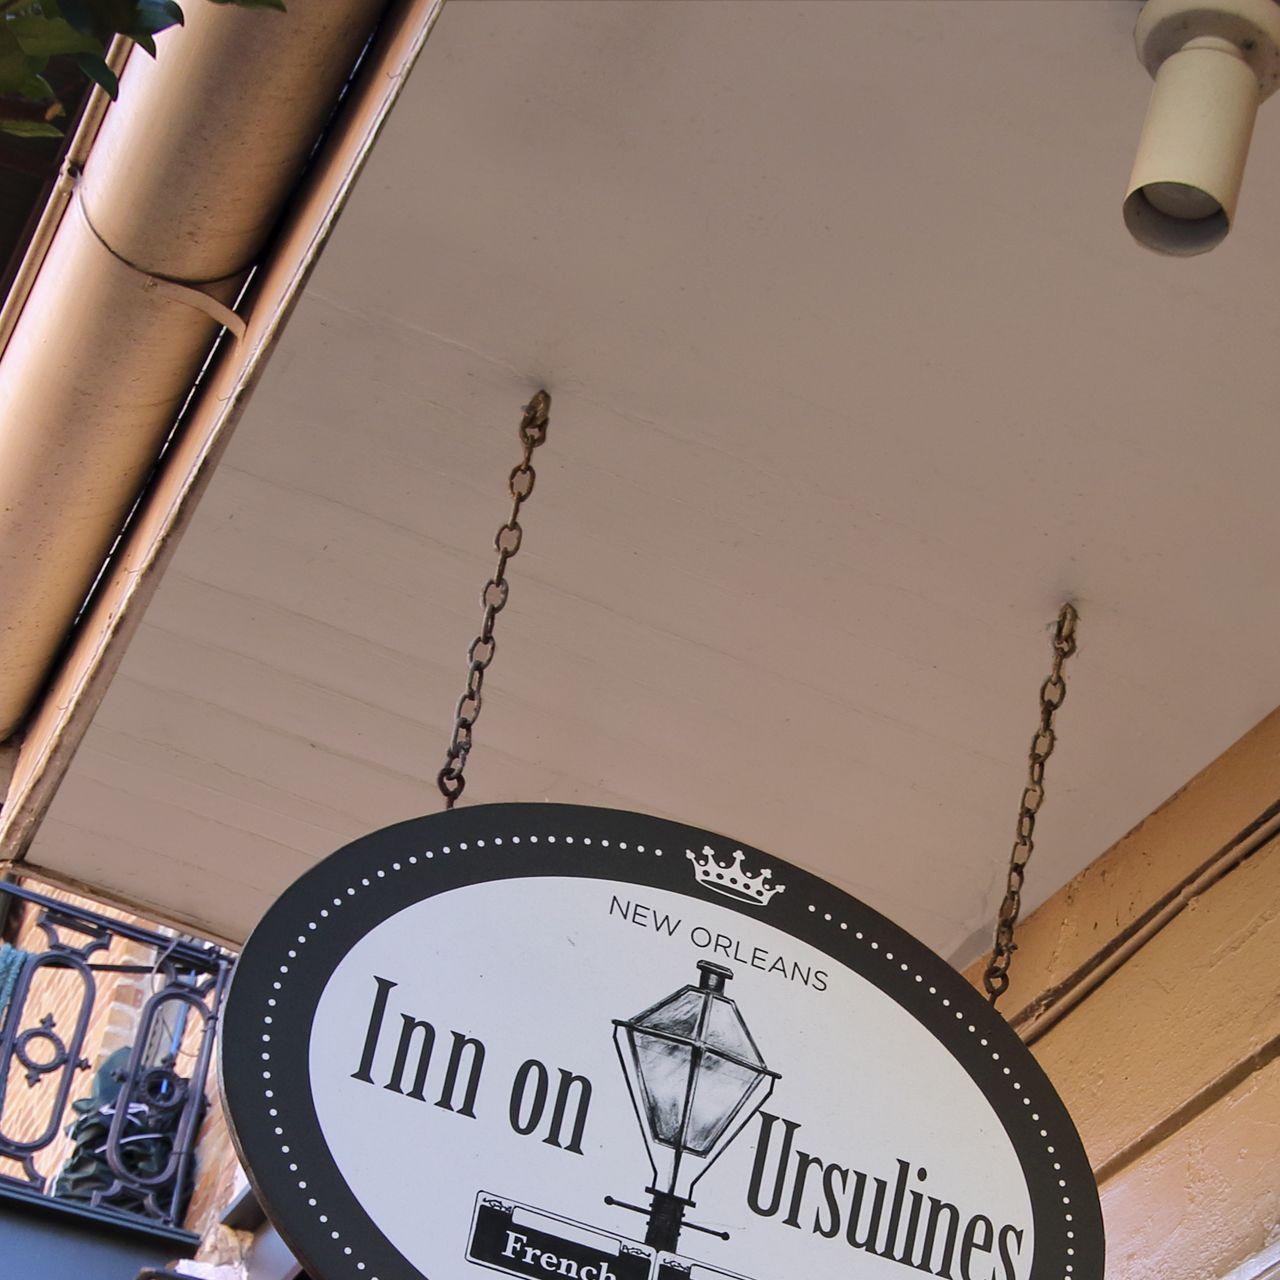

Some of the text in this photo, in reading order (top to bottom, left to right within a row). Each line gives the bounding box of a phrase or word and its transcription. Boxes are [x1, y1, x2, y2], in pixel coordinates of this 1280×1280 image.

[609, 895, 829, 992] NEW ORLEANS
[351, 976, 487, 1119] Inn
[508, 1058, 593, 1155] on
